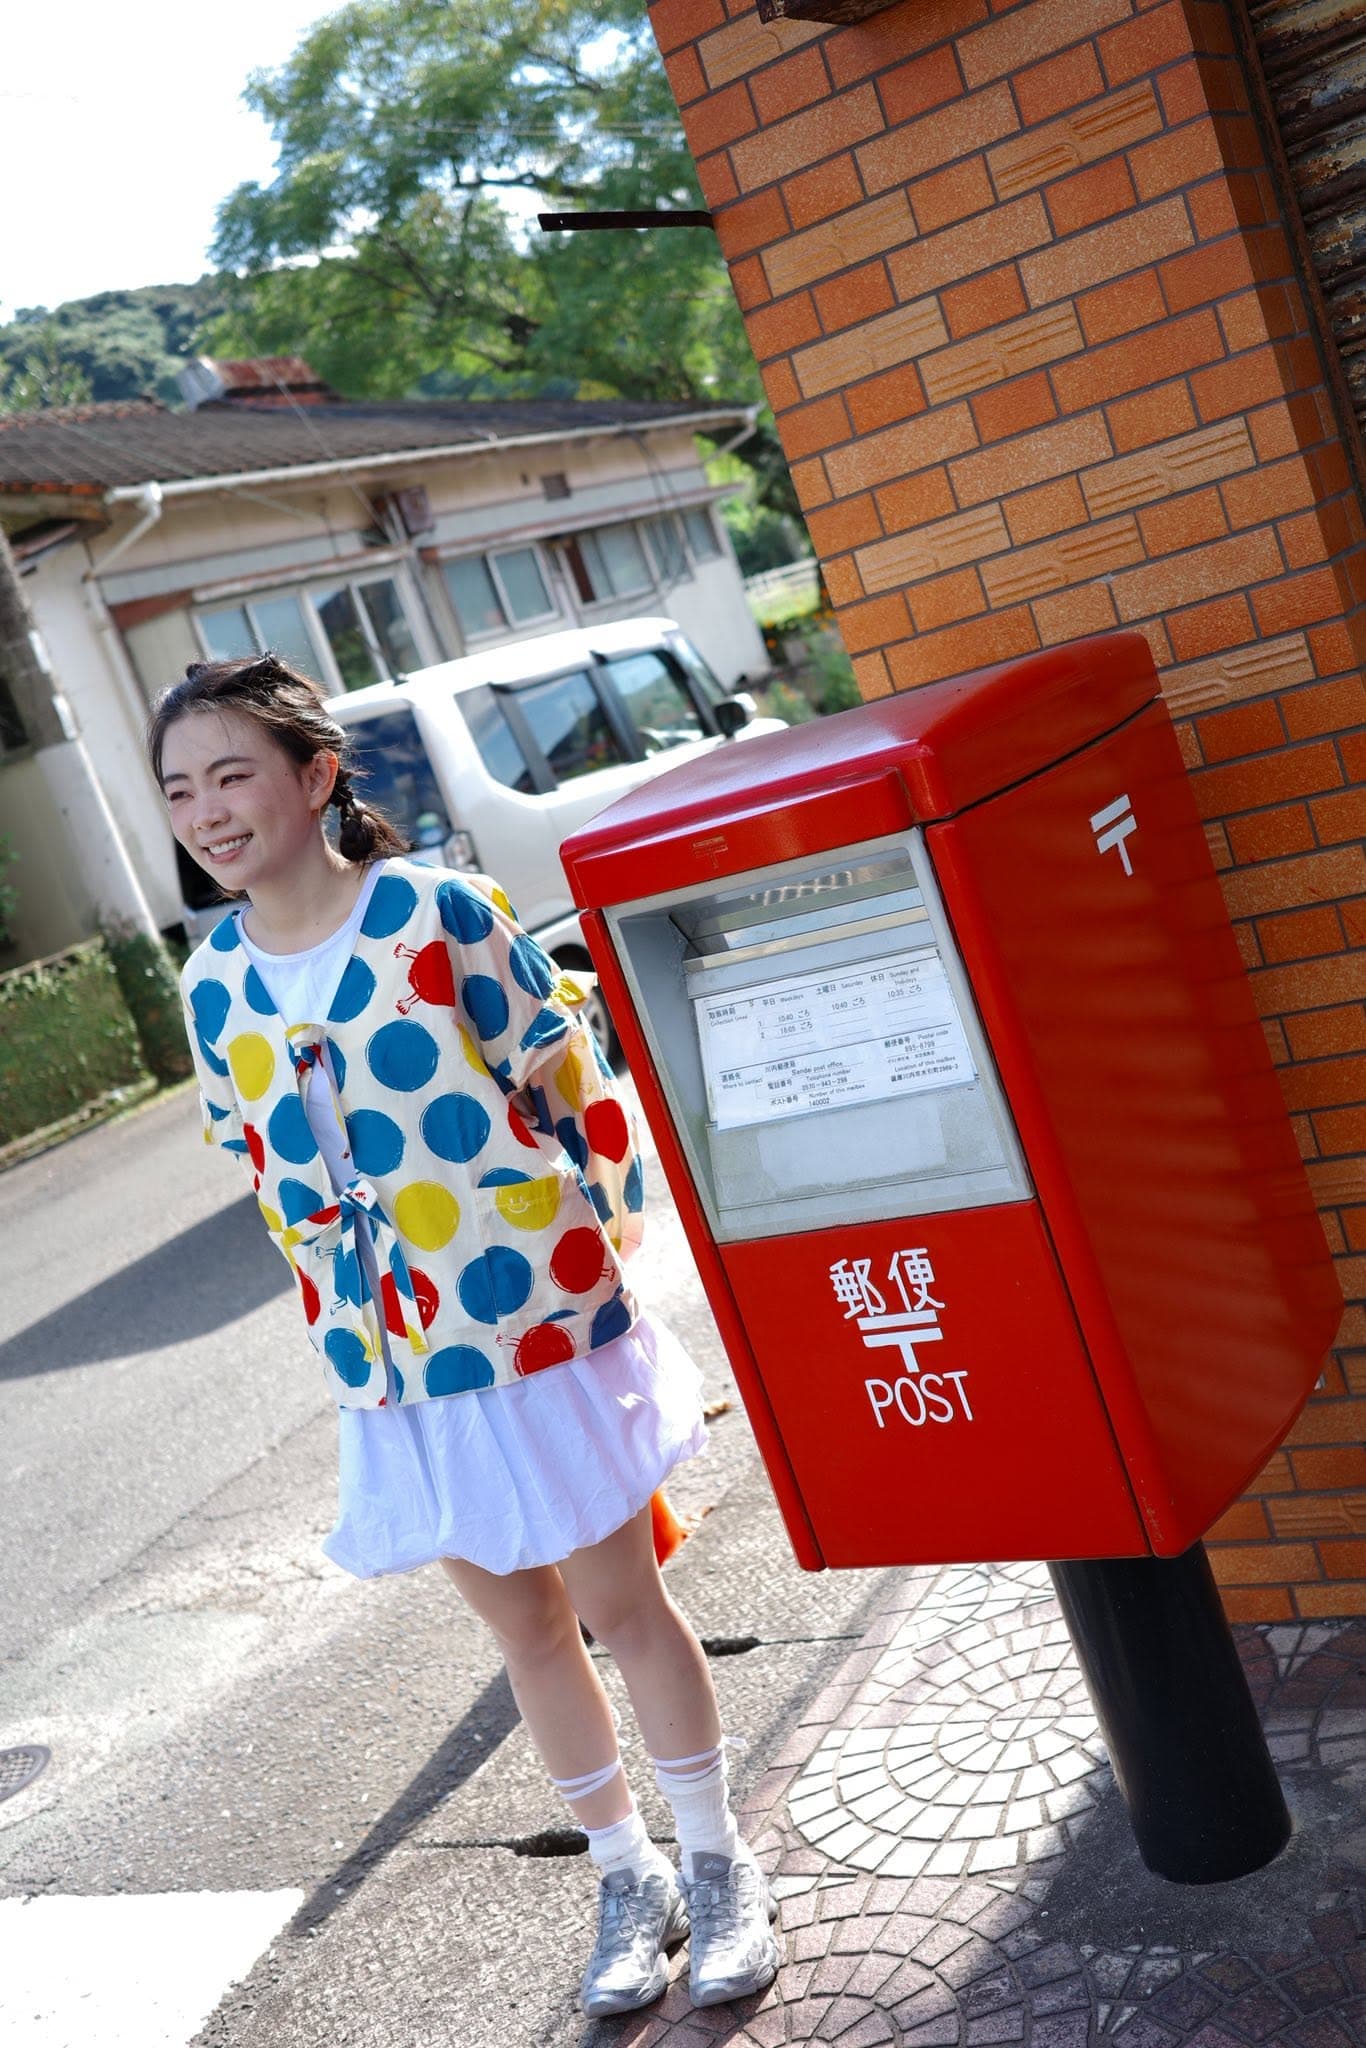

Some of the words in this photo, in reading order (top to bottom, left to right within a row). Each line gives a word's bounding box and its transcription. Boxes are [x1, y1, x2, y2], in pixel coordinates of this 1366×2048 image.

[870, 973, 885, 982] 休日
[816, 984, 837, 995] 土曜日
[909, 984, 922, 994] ごろ
[762, 997, 776, 1006] 平日
[852, 997, 865, 1006] ごろ
[798, 1009, 810, 1018] ごろ
[800, 1021, 813, 1030] ごろ
[829, 1247, 946, 1320] 郵便
[864, 1370, 973, 1428] POST
